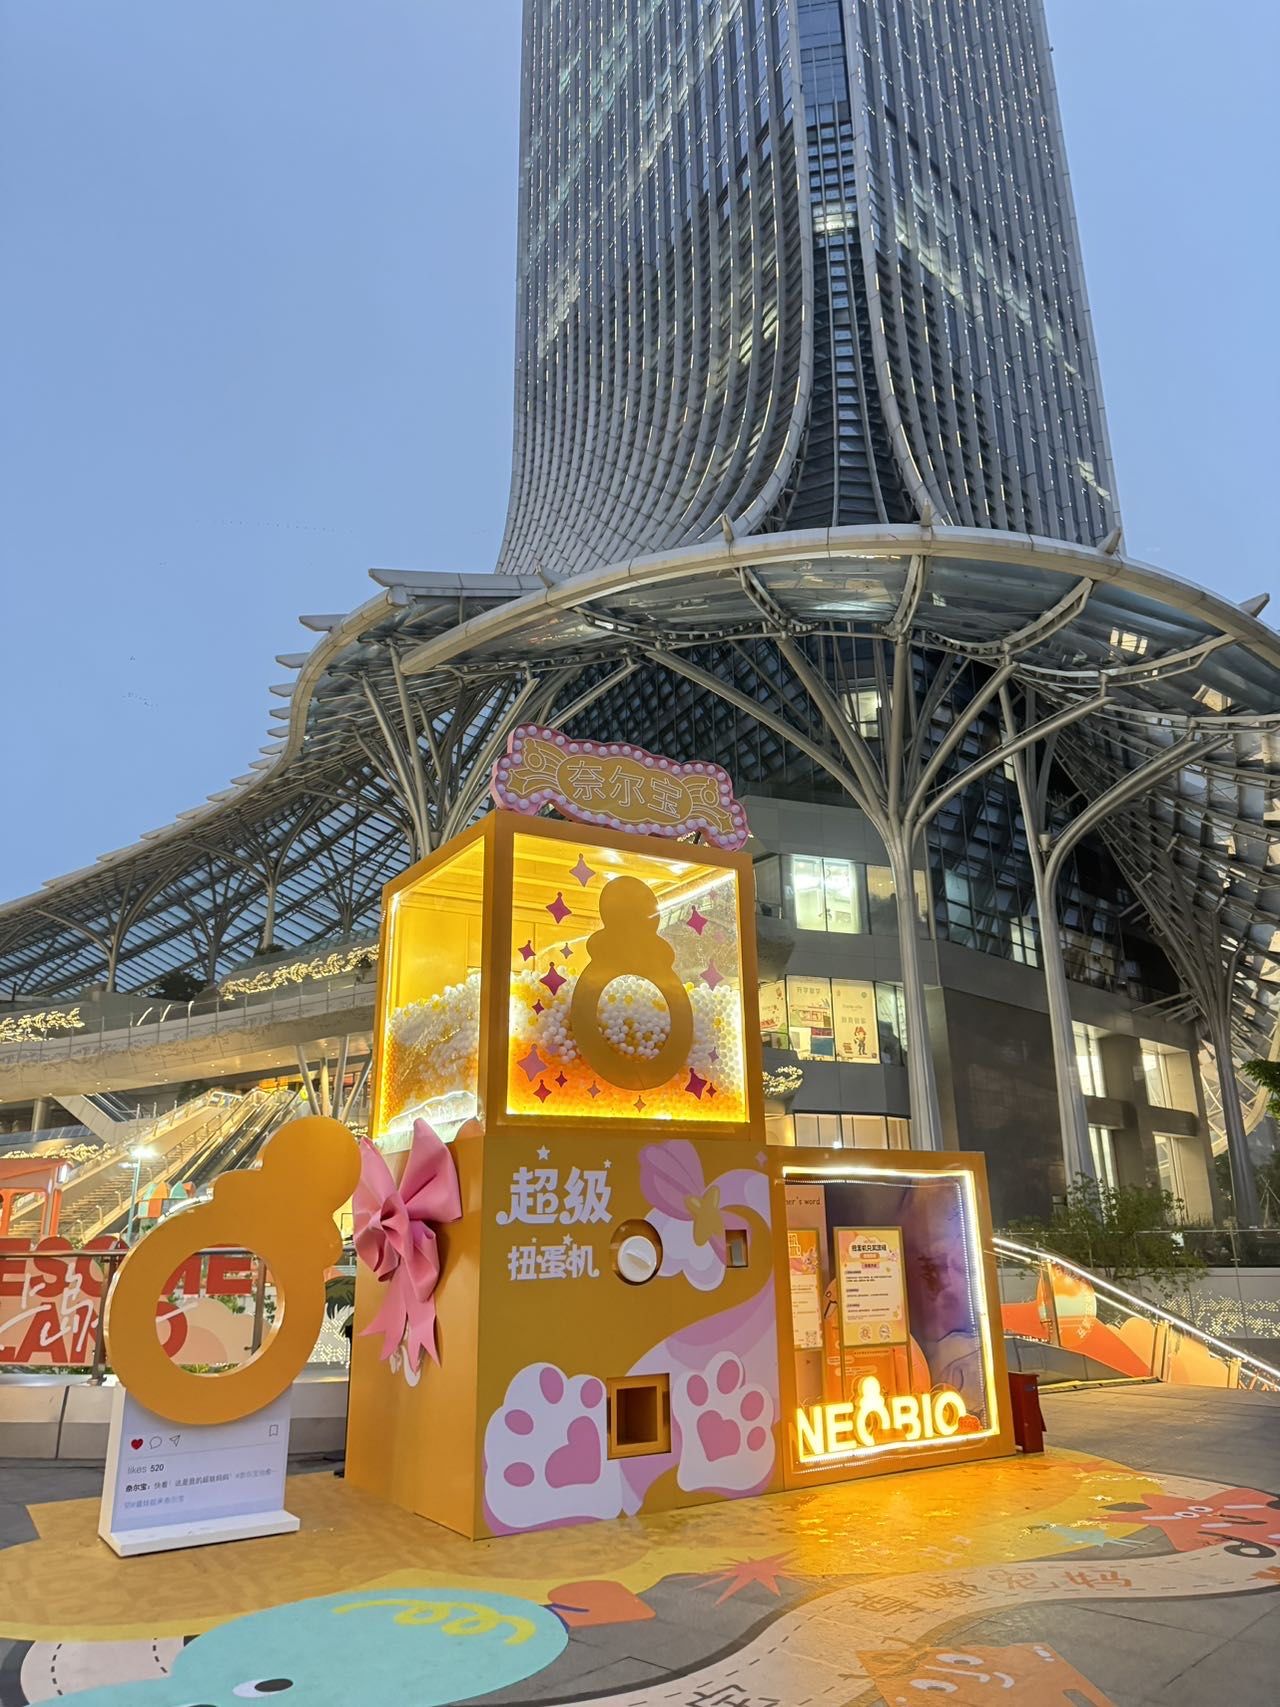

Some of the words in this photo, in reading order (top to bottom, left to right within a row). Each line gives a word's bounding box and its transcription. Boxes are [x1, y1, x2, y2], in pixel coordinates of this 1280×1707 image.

[567, 760, 682, 818] 奈尔宝
[496, 1167, 613, 1225] 超级
[507, 1243, 600, 1281] 扭蛋机
[796, 1376, 967, 1456] NEOBIO
[127, 1465, 147, 1475] likes
[150, 1464, 164, 1473] 520
